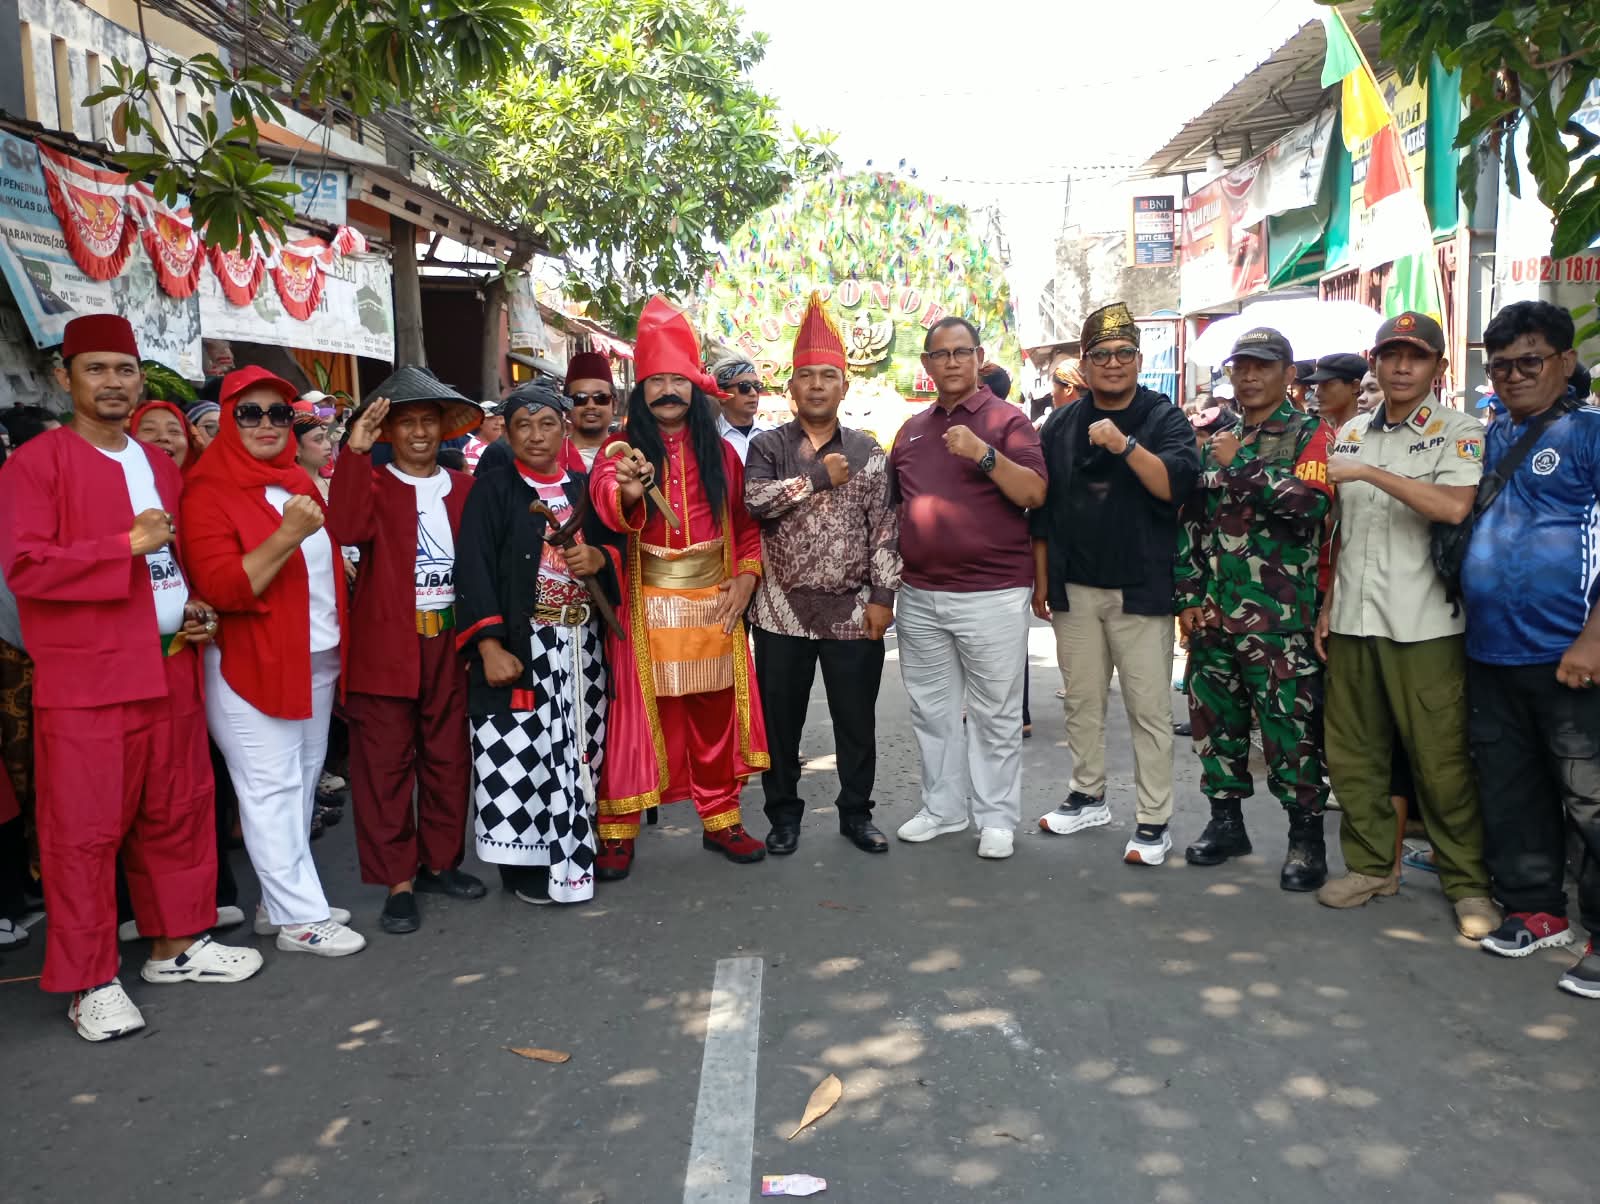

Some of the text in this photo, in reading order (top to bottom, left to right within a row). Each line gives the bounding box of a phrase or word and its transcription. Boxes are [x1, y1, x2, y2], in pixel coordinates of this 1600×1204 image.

[1149, 199, 1167, 209] BNI
[1409, 436, 1445, 455] POL PP
